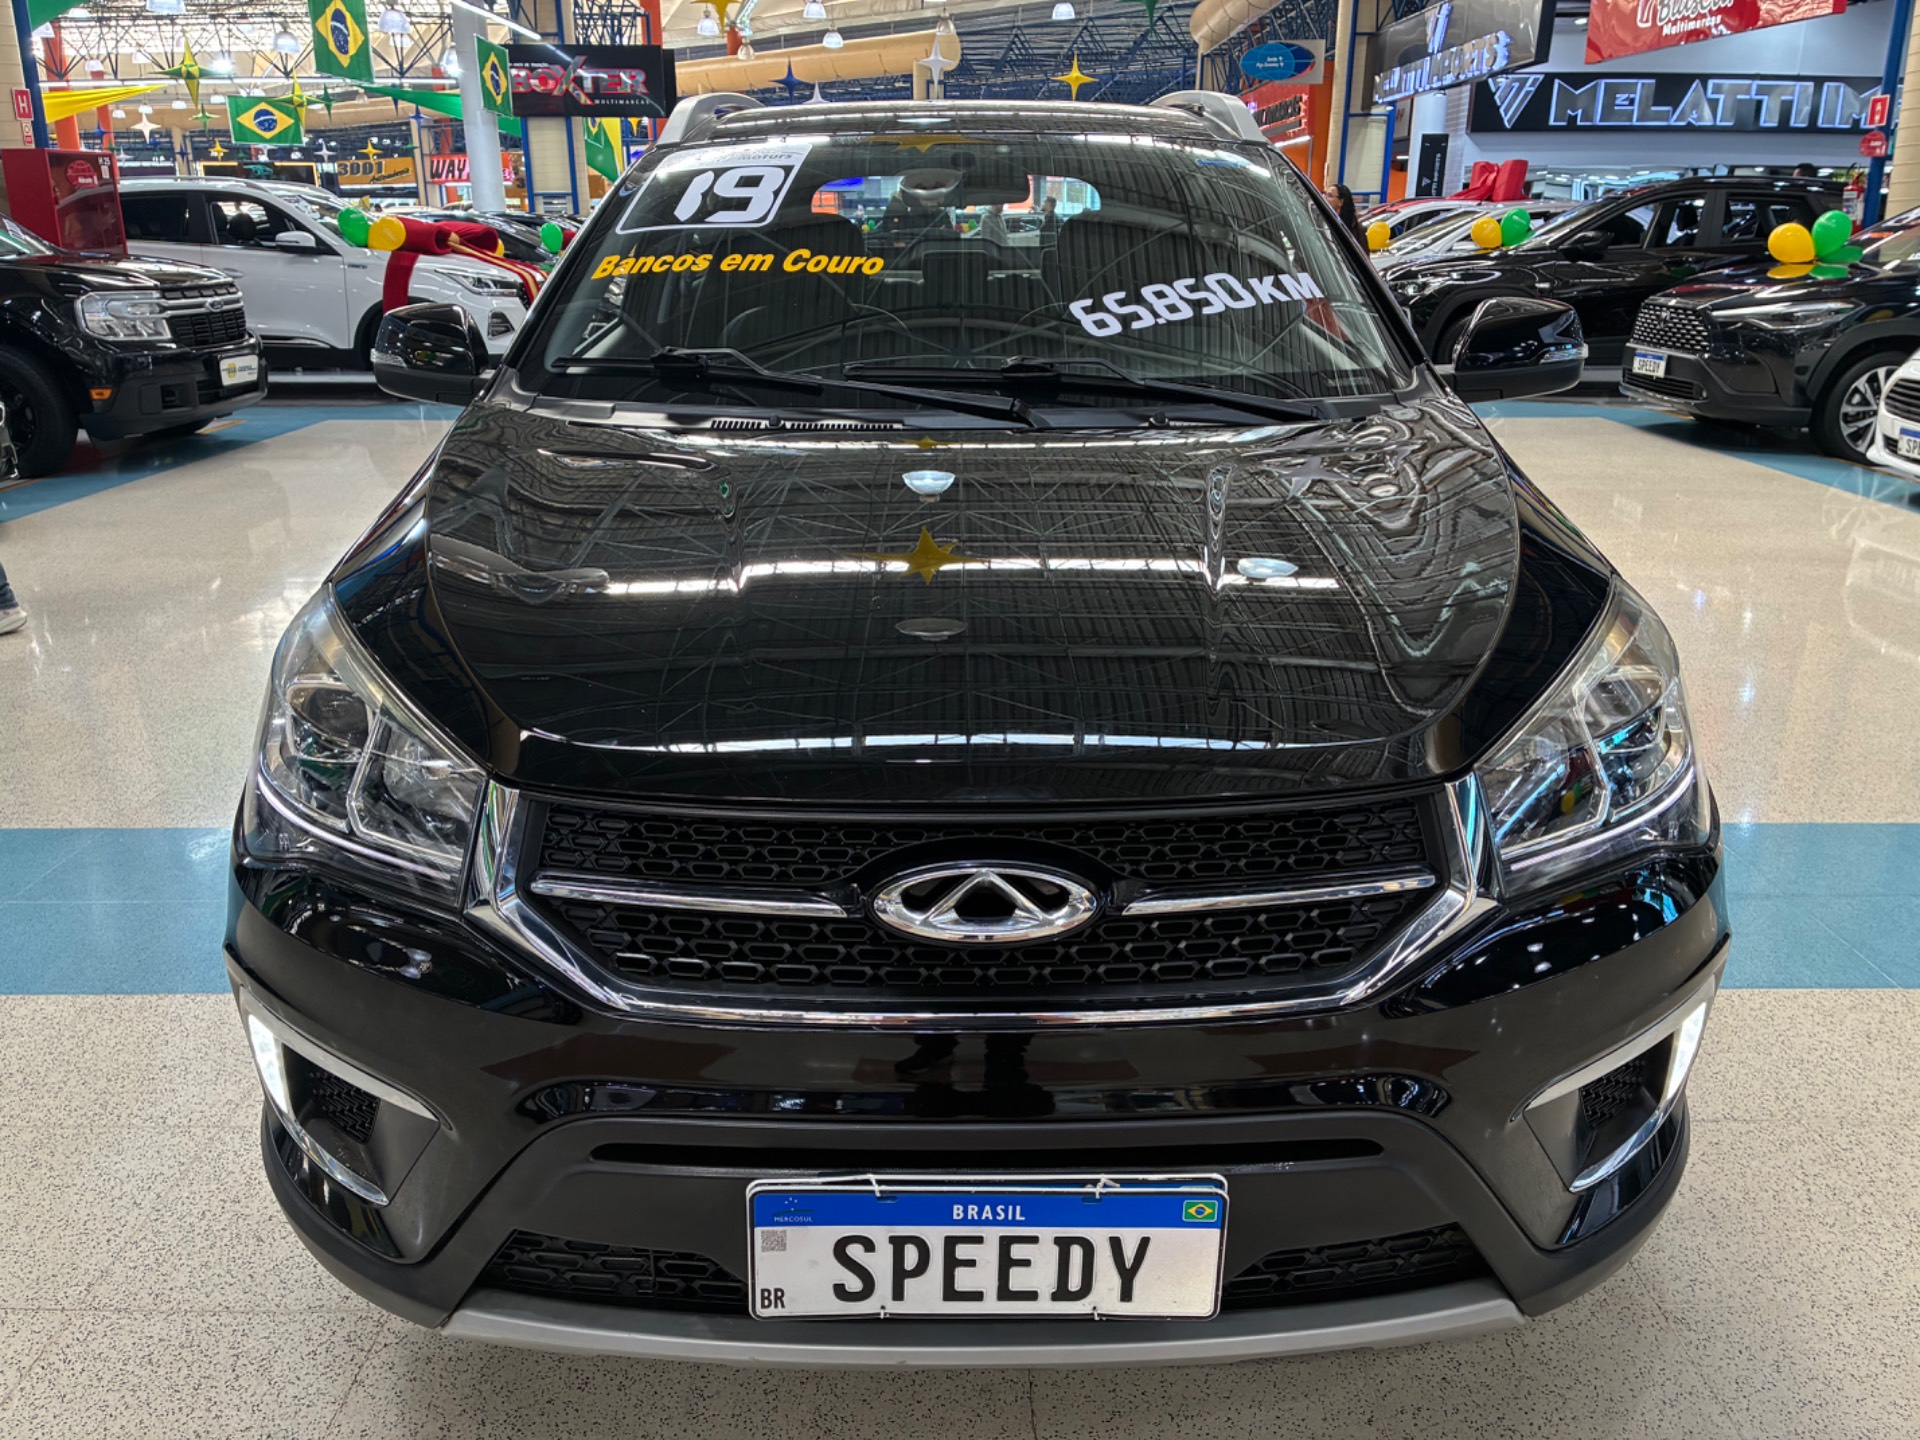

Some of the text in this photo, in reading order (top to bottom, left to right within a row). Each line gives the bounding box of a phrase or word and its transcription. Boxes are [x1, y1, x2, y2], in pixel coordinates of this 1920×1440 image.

[510, 56, 649, 105] BOXTER
[18, 95, 29, 114] H
[1549, 78, 1814, 128] MELATTI
[338, 160, 385, 177] 3001
[430, 159, 466, 180] WAY
[674, 166, 785, 222] 19
[591, 249, 884, 280] Bancos em Couro
[1906, 439, 1920, 455] SP
[952, 1205, 1025, 1221] BRASIL
[832, 1235, 1151, 1303] SPEEDY
[760, 1288, 785, 1310] BR
